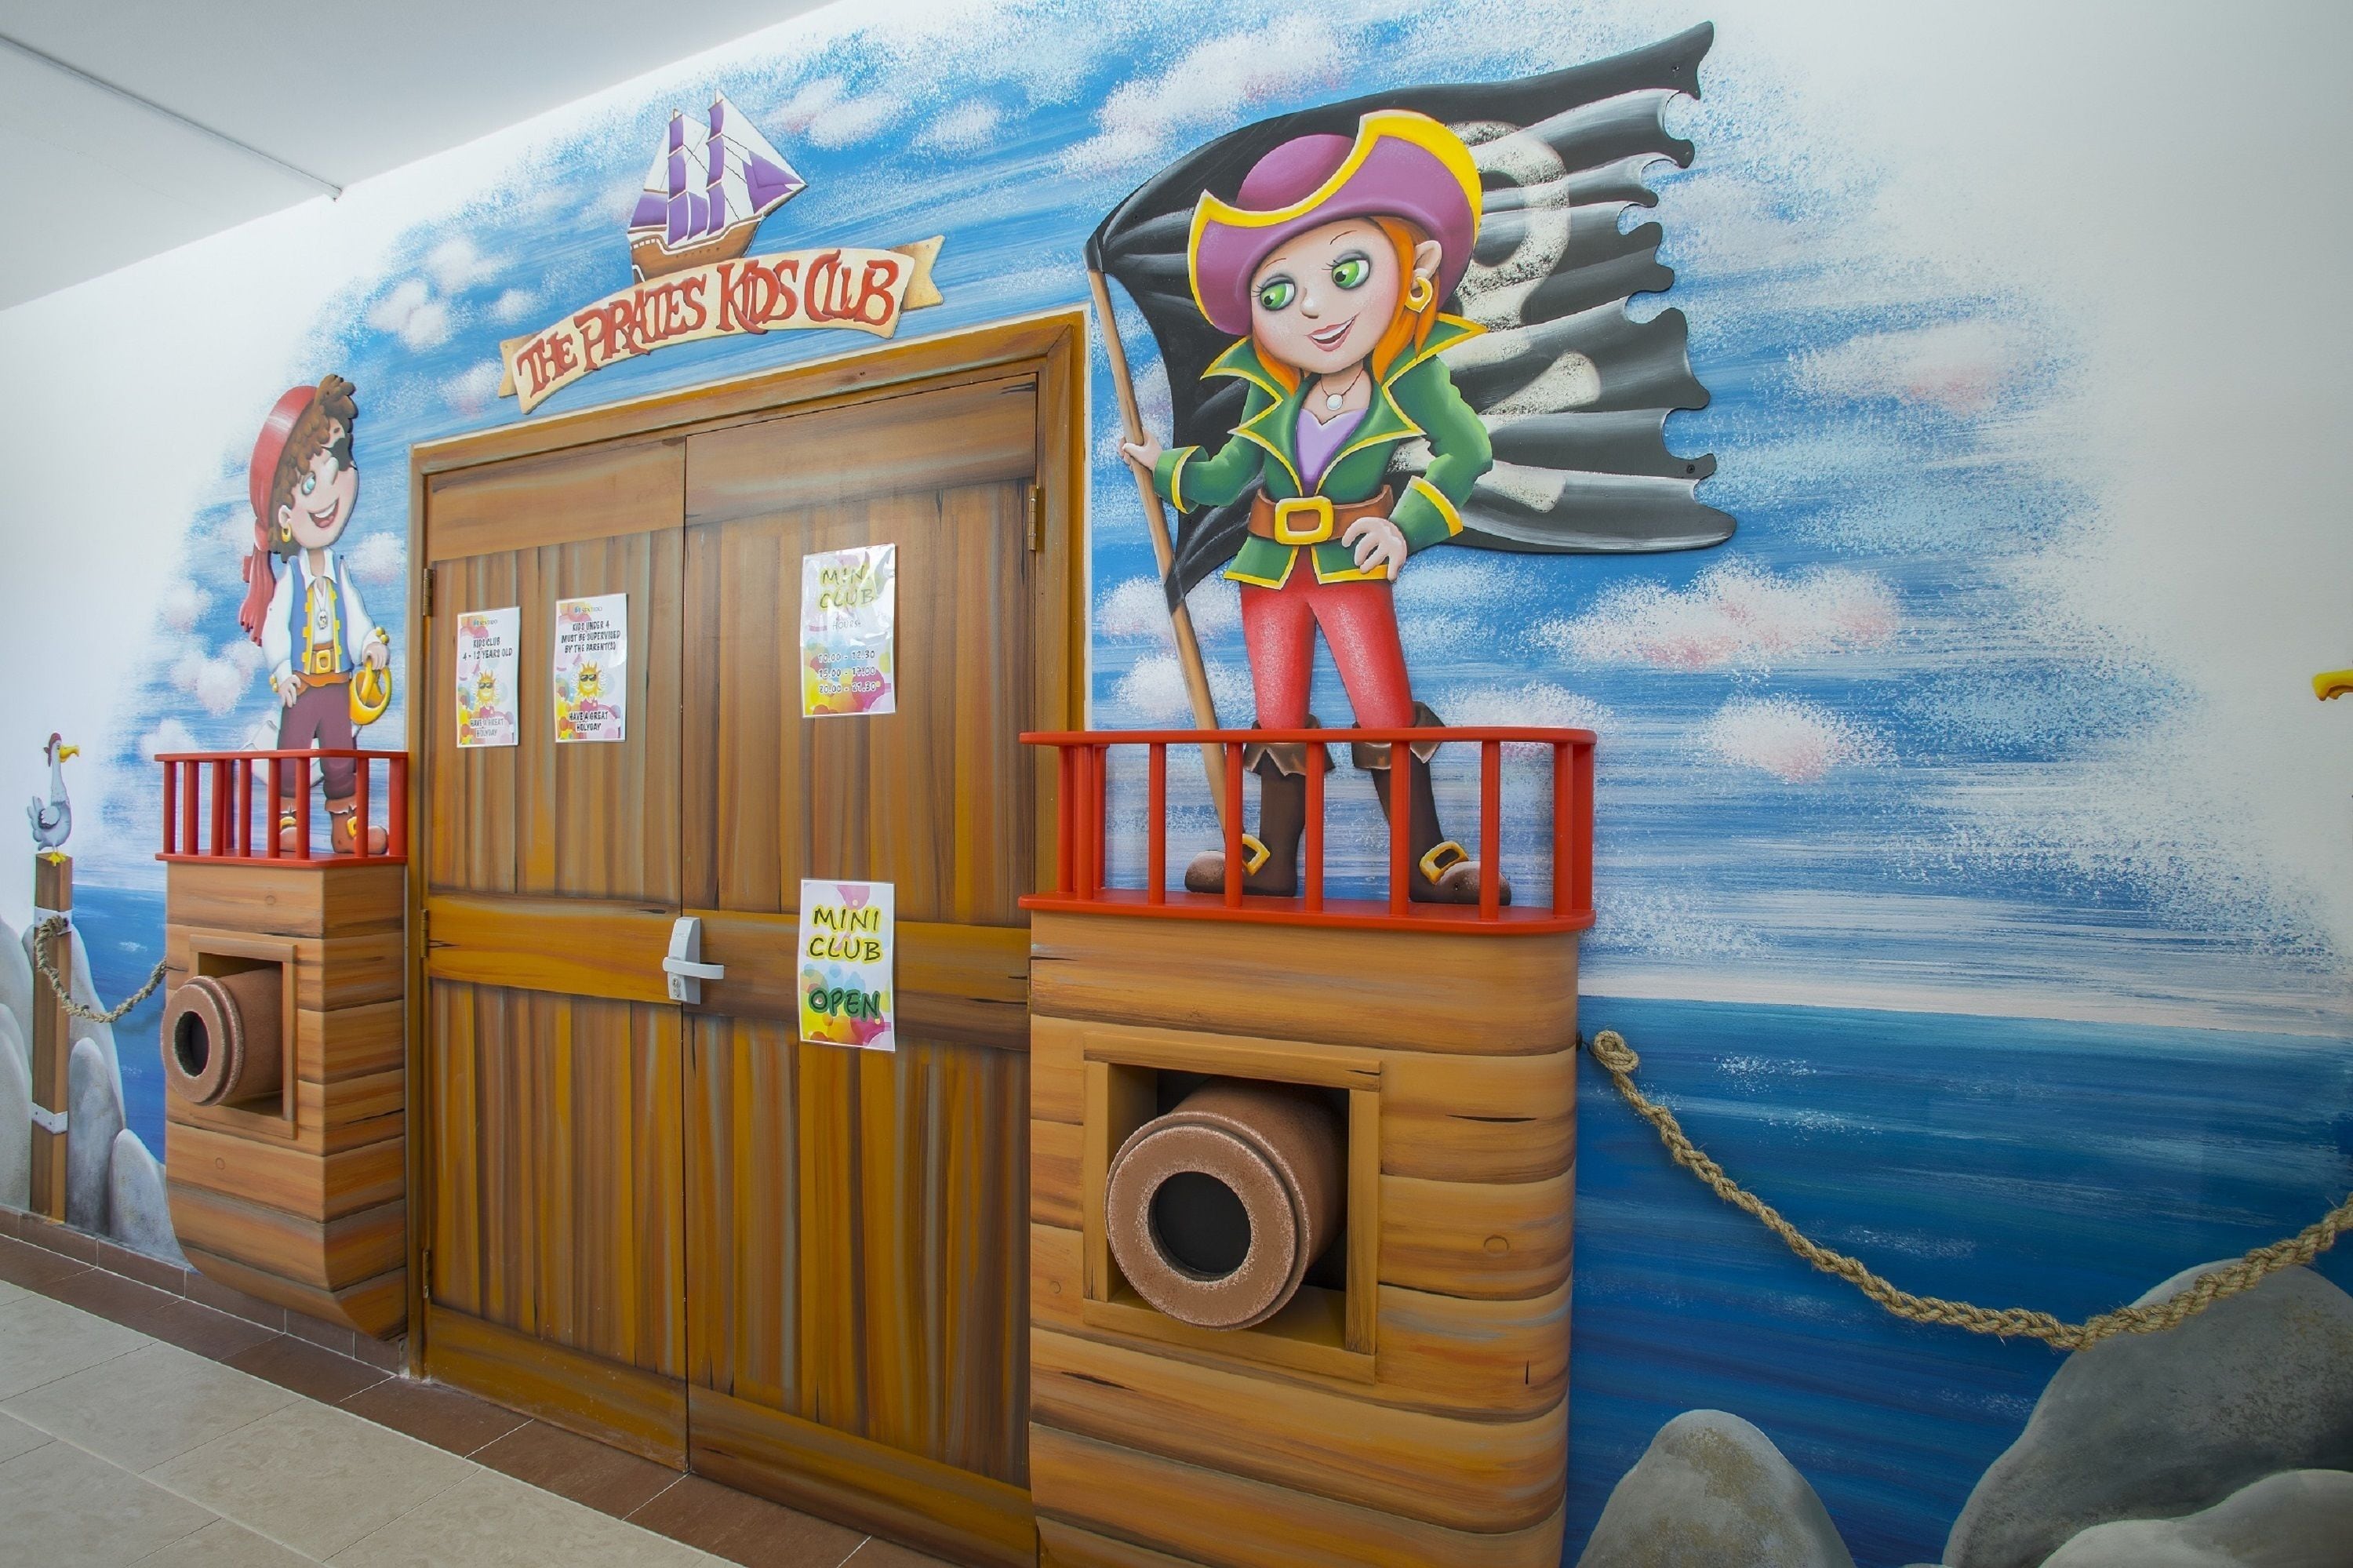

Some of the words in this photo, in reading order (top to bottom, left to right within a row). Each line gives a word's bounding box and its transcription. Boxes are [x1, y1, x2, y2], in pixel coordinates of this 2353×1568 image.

[517, 330, 577, 398] THE
[573, 274, 707, 373] PIRATES
[716, 258, 799, 335] KIDS
[804, 249, 899, 326] CLUB
[822, 565, 871, 585] MIN
[820, 588, 875, 609] CLUB
[573, 623, 584, 631] KIDS
[586, 620, 604, 631] UNDER
[606, 620, 609, 629] 4
[473, 638, 486, 649] KIDS
[486, 636, 500, 646] CLUB
[561, 634, 578, 644] MUST
[579, 633, 586, 642] BE
[587, 630, 621, 641] SUPERVISED
[463, 652, 467, 660] 4
[474, 650, 480, 660] 12
[482, 649, 500, 659] YEARS
[502, 647, 512, 657] OLD
[565, 645, 573, 653] BY
[574, 643, 584, 653] THE
[569, 711, 583, 721] HAVE
[590, 711, 608, 720] GREAT
[813, 907, 879, 932] MINI
[809, 937, 881, 962] CLUB
[809, 988, 880, 1020] OPEN
